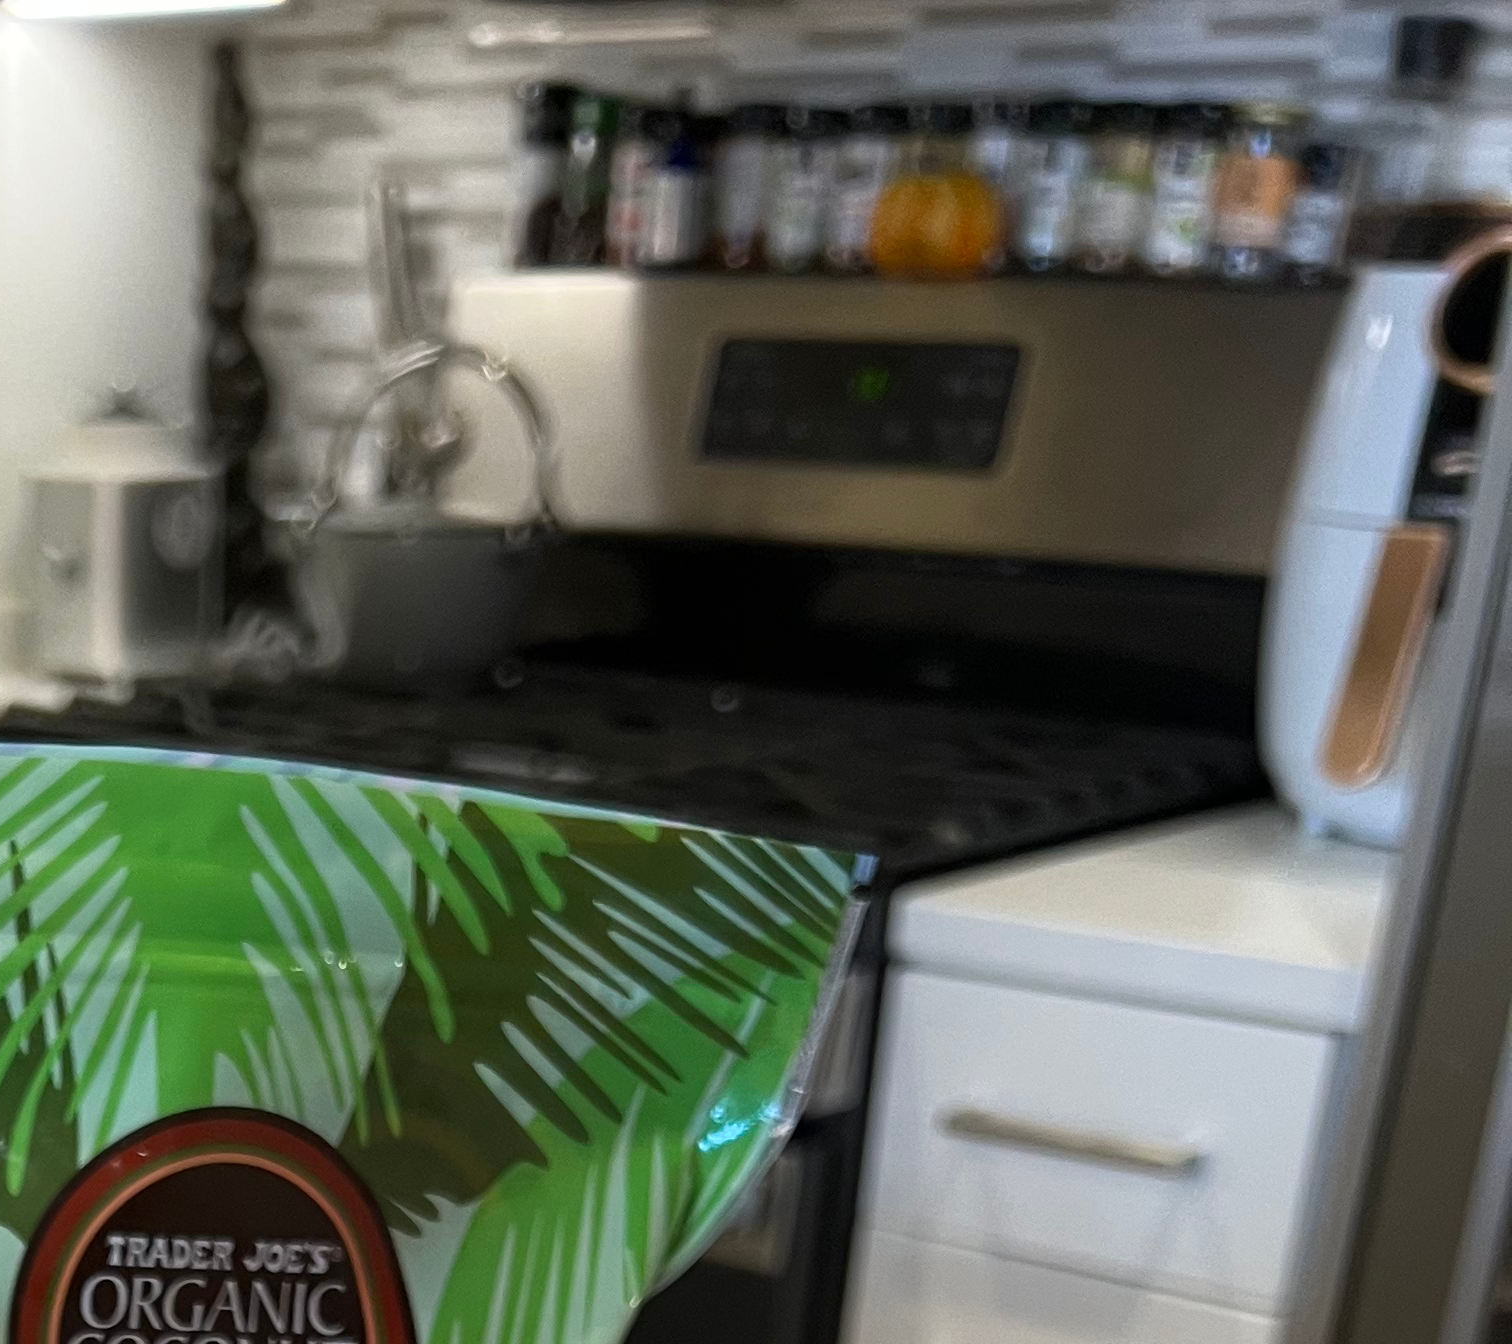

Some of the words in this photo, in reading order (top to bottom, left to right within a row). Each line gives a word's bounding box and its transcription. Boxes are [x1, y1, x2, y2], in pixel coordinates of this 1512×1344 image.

[106, 1235, 235, 1271] TRADER
[243, 1241, 333, 1274] JOE'S
[80, 1275, 345, 1336] ORGANIC
